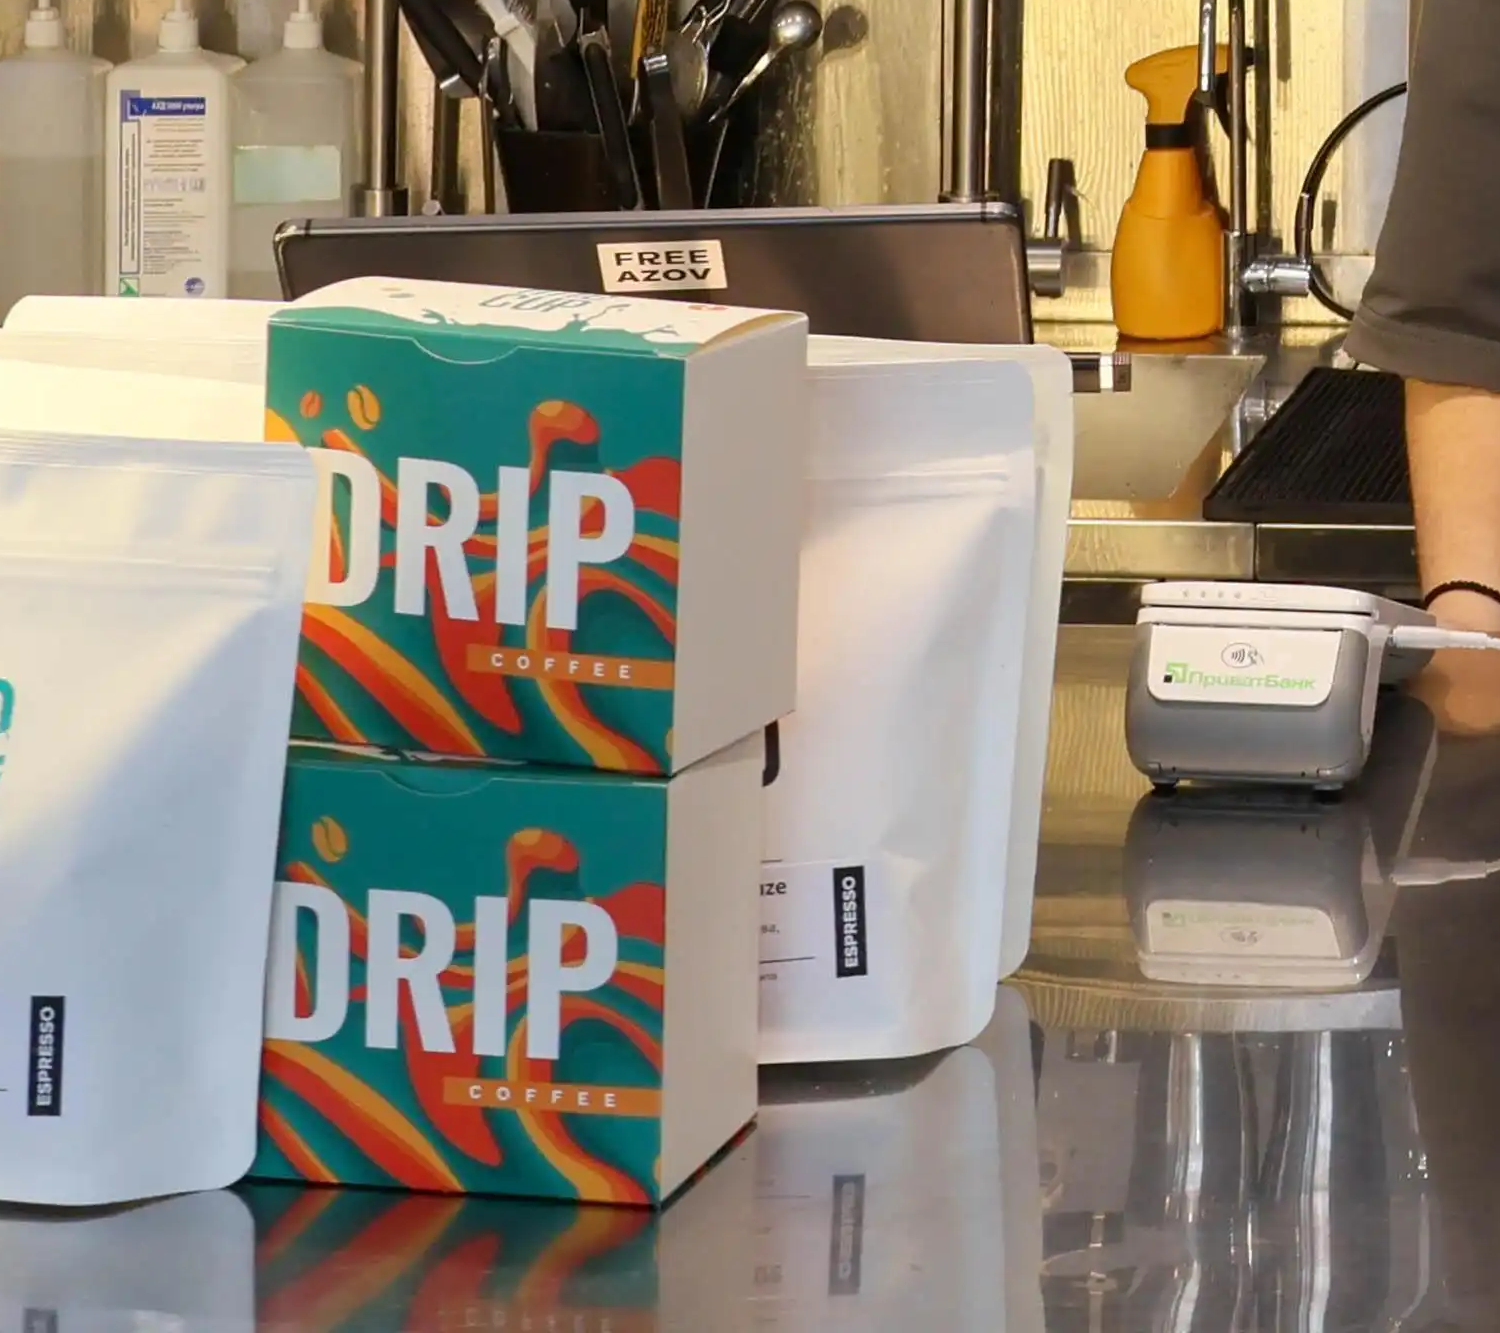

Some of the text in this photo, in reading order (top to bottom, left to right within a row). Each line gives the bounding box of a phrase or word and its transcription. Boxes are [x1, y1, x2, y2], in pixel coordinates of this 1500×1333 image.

[614, 250, 709, 266] FREE
[617, 269, 710, 282] AZOV
[308, 448, 636, 630] DRIP
[490, 653, 632, 680] COFFEE
[1189, 668, 1315, 689] ПриватБанк
[842, 876, 858, 968] ESPRESSO
[267, 880, 618, 1061] DRIP
[35, 1005, 55, 1107] ESPRESSO
[468, 1084, 618, 1109] COFFEE
